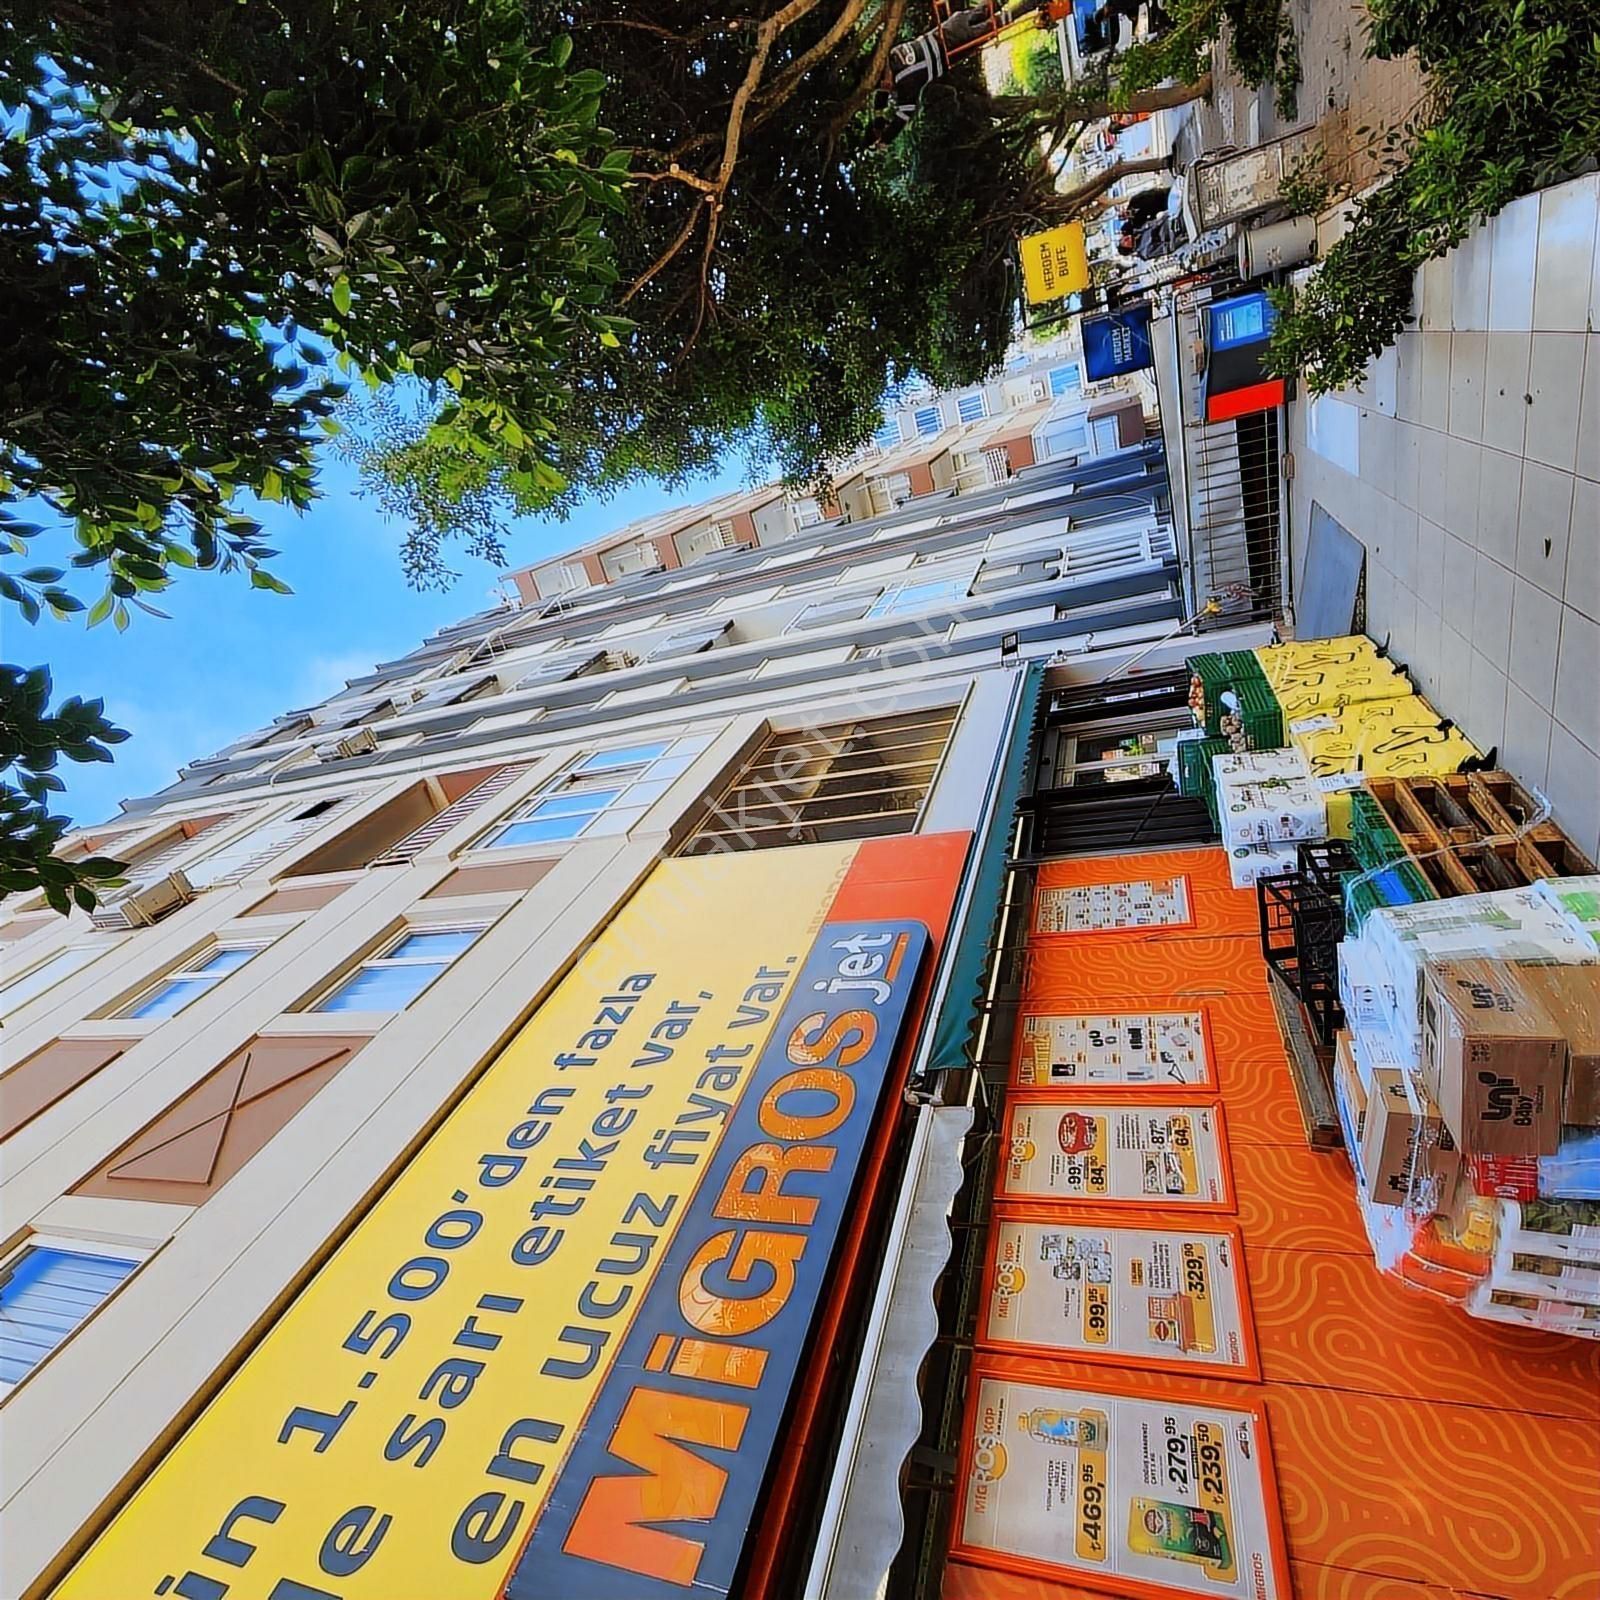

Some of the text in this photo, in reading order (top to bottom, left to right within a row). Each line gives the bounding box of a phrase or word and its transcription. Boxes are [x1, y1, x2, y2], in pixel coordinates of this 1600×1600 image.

[1040, 242, 1055, 290] HERDEM
[1122, 326, 1133, 362] MARKET
[811, 931, 894, 1005] jet
[276, 1086, 577, 1453] 1.500'den
[552, 972, 657, 1071] fazla
[383, 1293, 525, 1468] sarı
[511, 1083, 654, 1266] etiket
[630, 989, 714, 1067] var,
[451, 955, 797, 1564] en ucuz fiyat var.
[1164, 1416, 1188, 1495] ₺279,95
[1197, 1424, 1225, 1505] ₺239,50
[1081, 1464, 1105, 1551] ₺469,95
